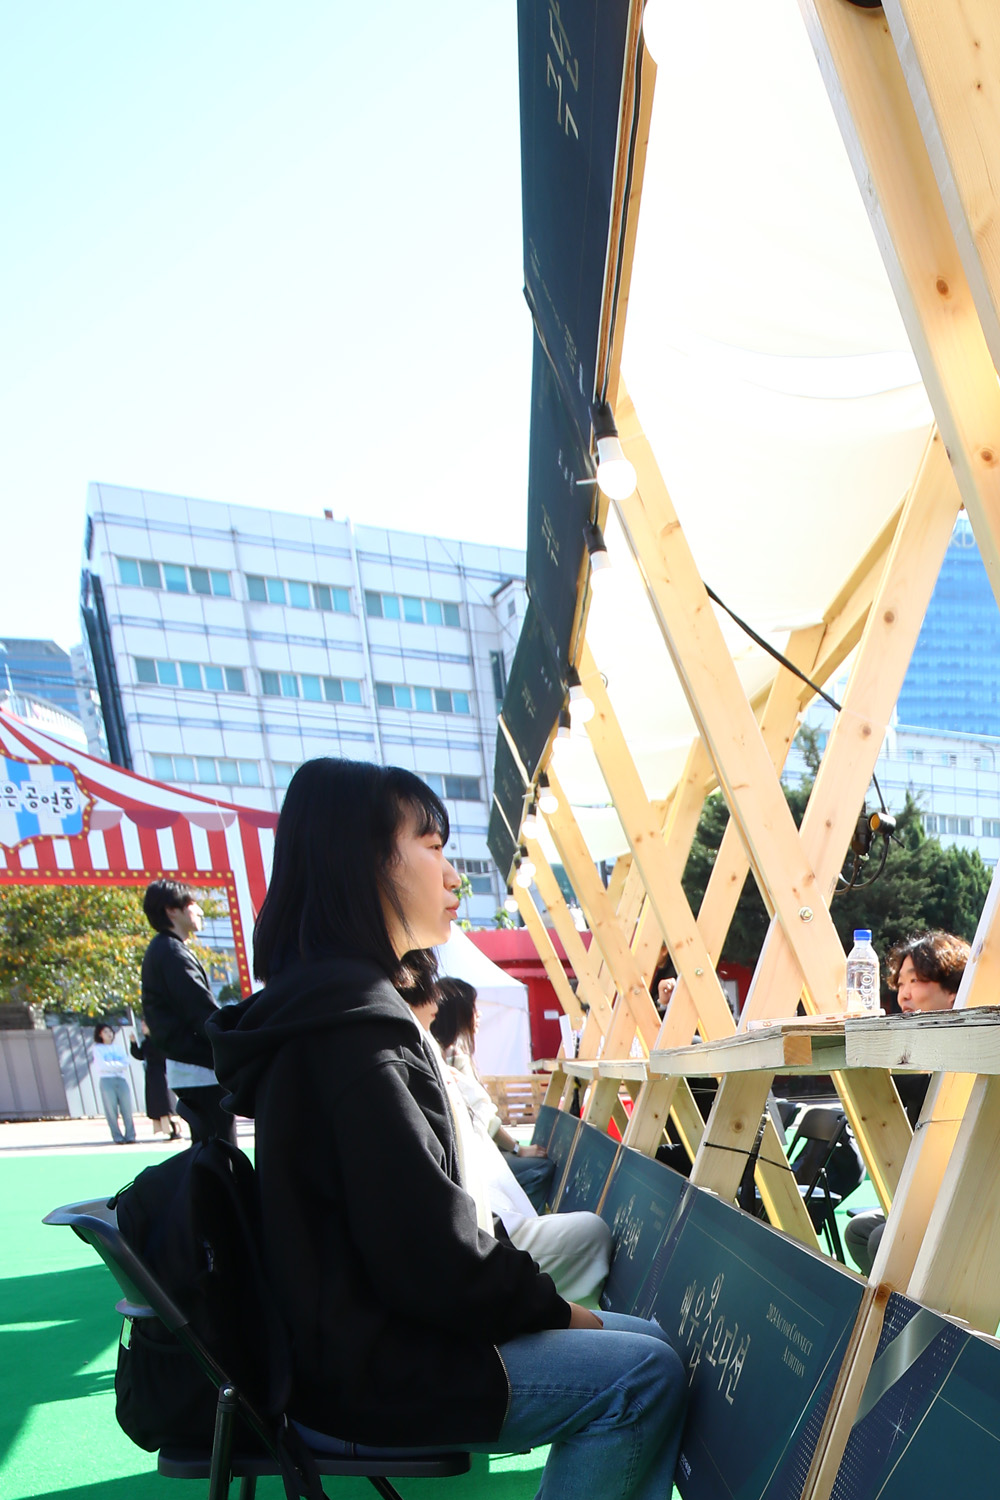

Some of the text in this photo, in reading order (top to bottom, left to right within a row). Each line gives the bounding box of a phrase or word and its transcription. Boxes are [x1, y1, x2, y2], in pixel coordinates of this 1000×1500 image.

[0, 786, 74, 813] 은 공연중
[678, 1272, 751, 1406] 배우 잇다 오디션
[781, 1345, 806, 1378] AUDITION
